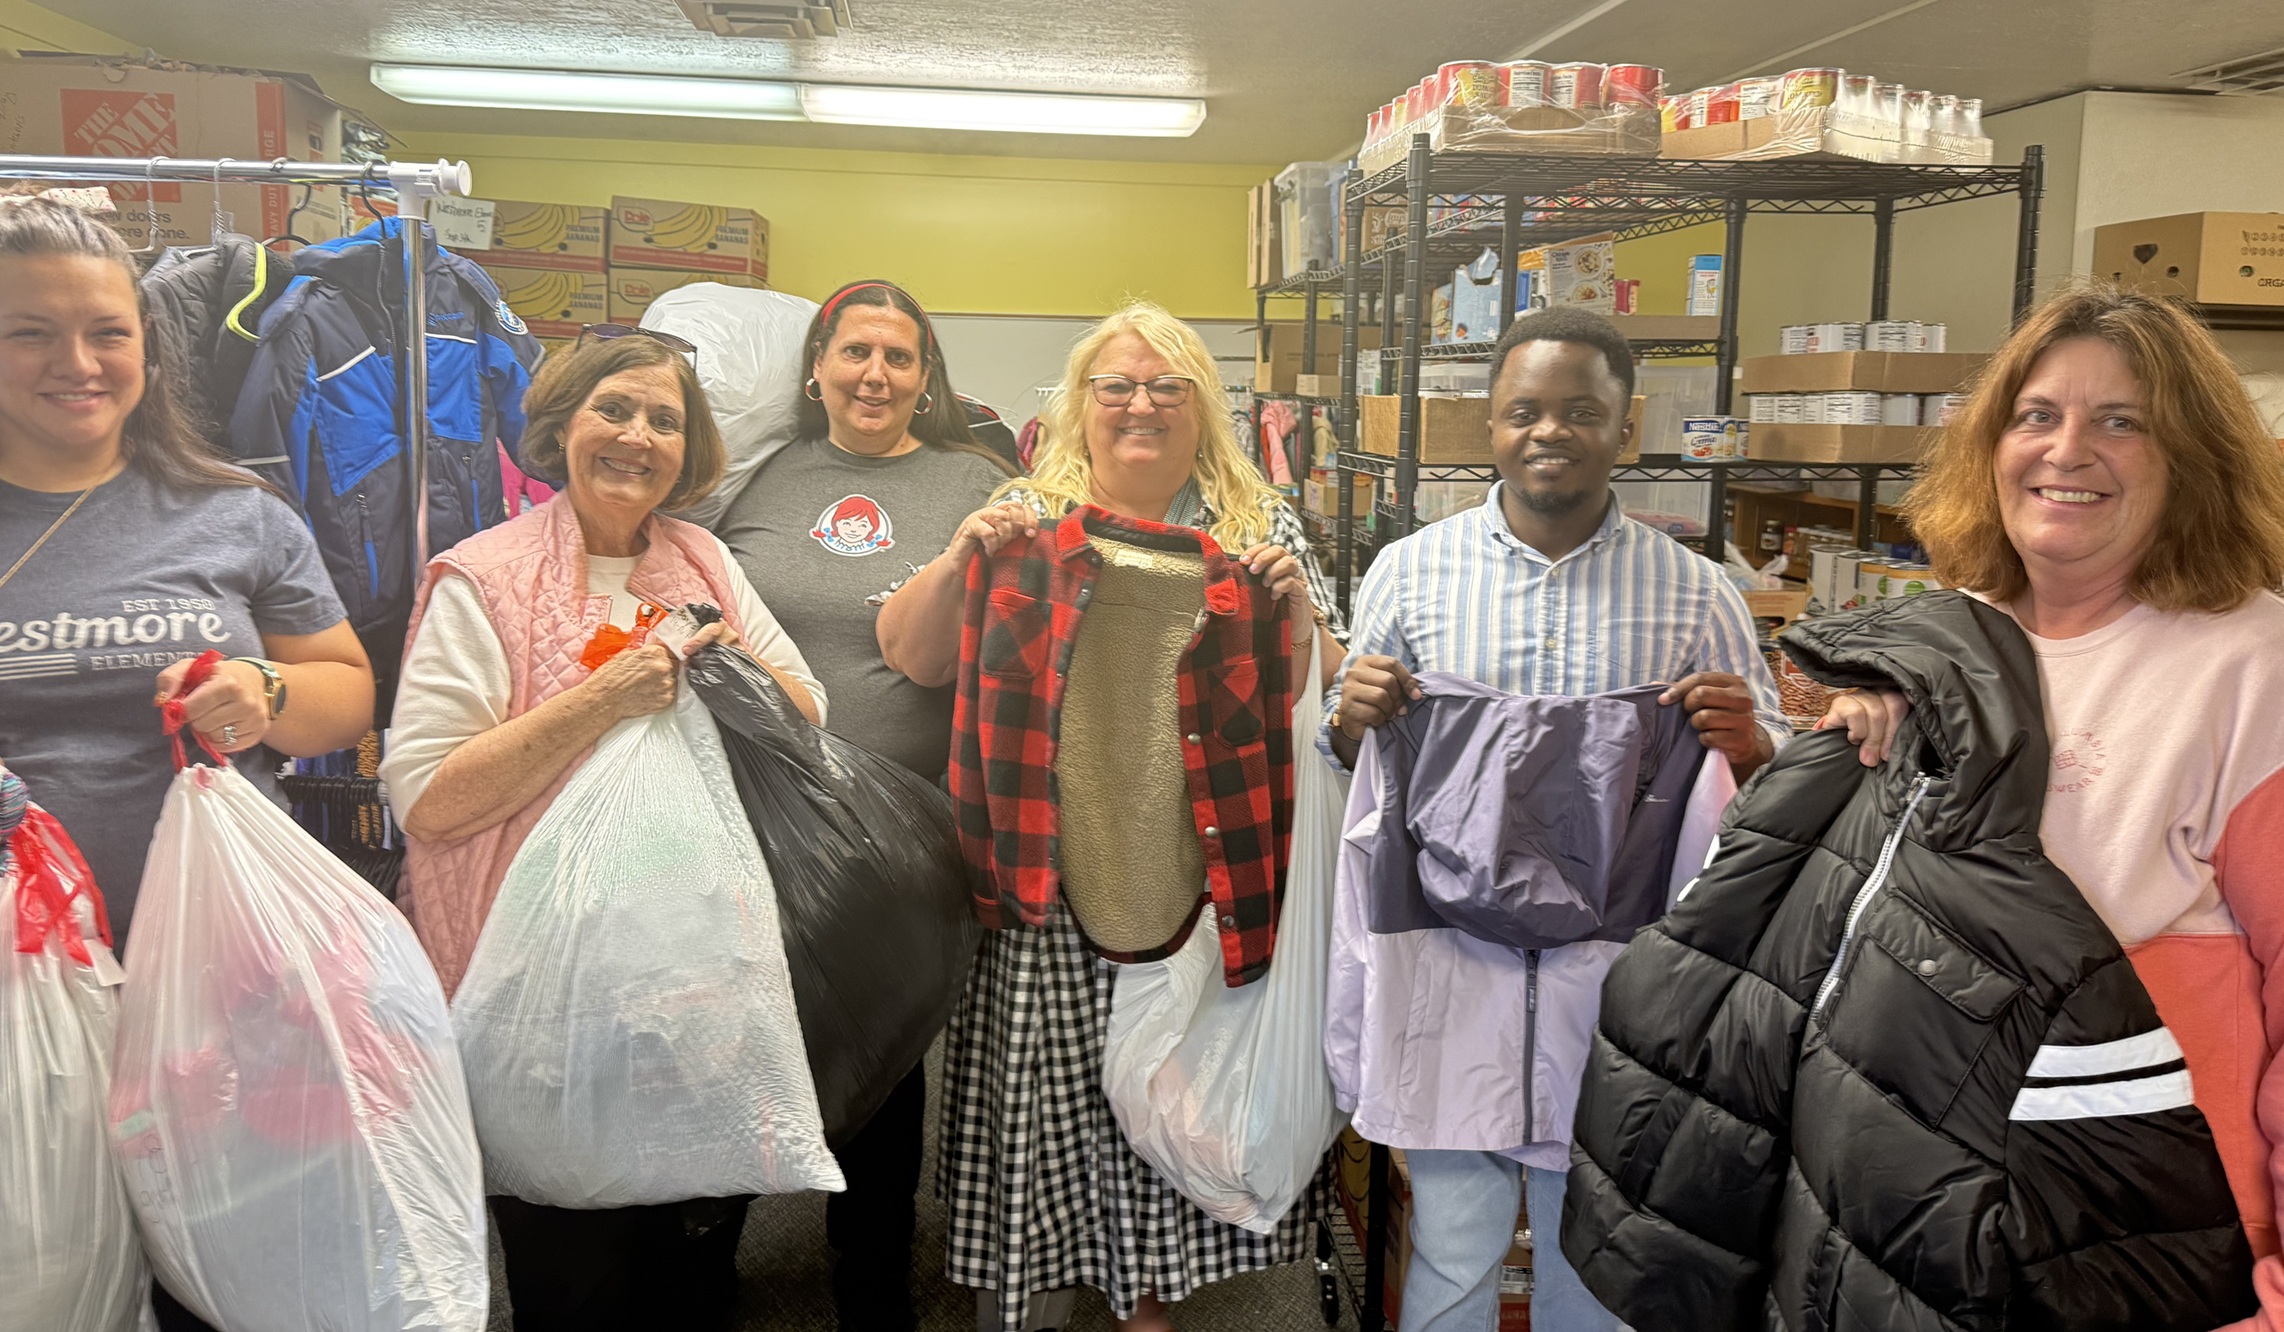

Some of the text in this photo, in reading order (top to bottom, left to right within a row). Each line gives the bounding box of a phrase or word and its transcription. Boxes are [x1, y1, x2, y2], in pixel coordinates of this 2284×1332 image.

[73, 101, 120, 145] THE
[263, 129, 275, 157] RGE
[267, 185, 278, 208] DUT
[126, 209, 172, 223] dors
[624, 210, 650, 224] Dole
[115, 226, 190, 240] ore one.
[566, 224, 600, 234] PREMIUM
[715, 225, 749, 236] PREMIUM
[565, 233, 599, 243] BANANAS
[715, 234, 749, 245] BANANAS
[624, 283, 650, 295] Dole
[569, 292, 604, 301] PREMIUM
[569, 300, 603, 310] BANANAS
[122, 599, 160, 613] EST
[0, 612, 232, 652] estmore
